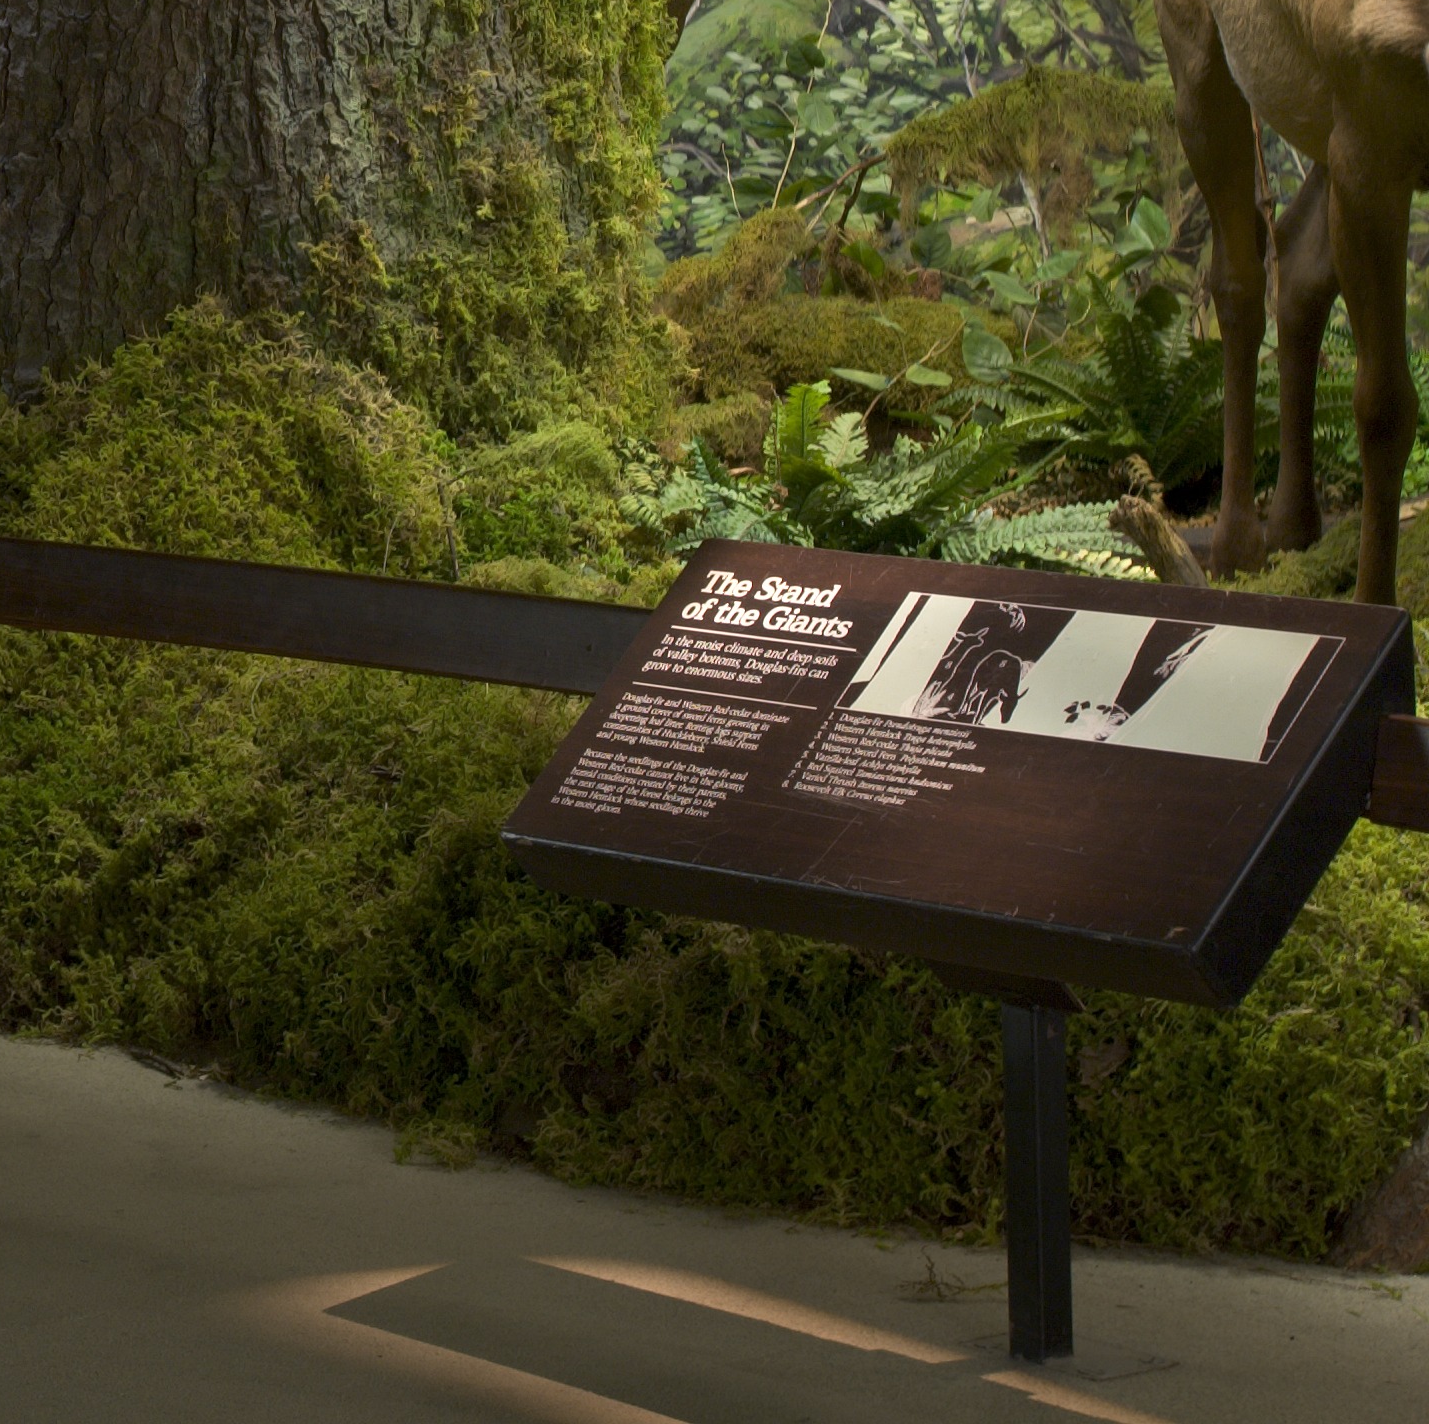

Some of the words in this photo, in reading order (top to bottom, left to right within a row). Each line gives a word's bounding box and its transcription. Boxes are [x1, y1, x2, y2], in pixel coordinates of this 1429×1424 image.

[701, 570, 753, 598] The
[754, 576, 841, 608] Stand
[681, 597, 719, 621] of
[713, 600, 760, 627] the
[762, 606, 853, 638] Giants
[652, 646, 669, 657] of
[667, 648, 699, 664] valley
[698, 651, 742, 669] bottoms,
[744, 658, 808, 677] Douglas-firs
[808, 669, 830, 680] can
[661, 633, 675, 645] In
[674, 635, 694, 648] the
[693, 640, 725, 652] moist
[723, 641, 764, 657] climate
[763, 648, 789, 660] and
[786, 649, 813, 667] deep
[812, 654, 839, 667] soils
[641, 660, 672, 672] grow
[671, 661, 689, 673] to
[684, 666, 737, 681] enormous
[736, 671, 768, 684] sizes.
